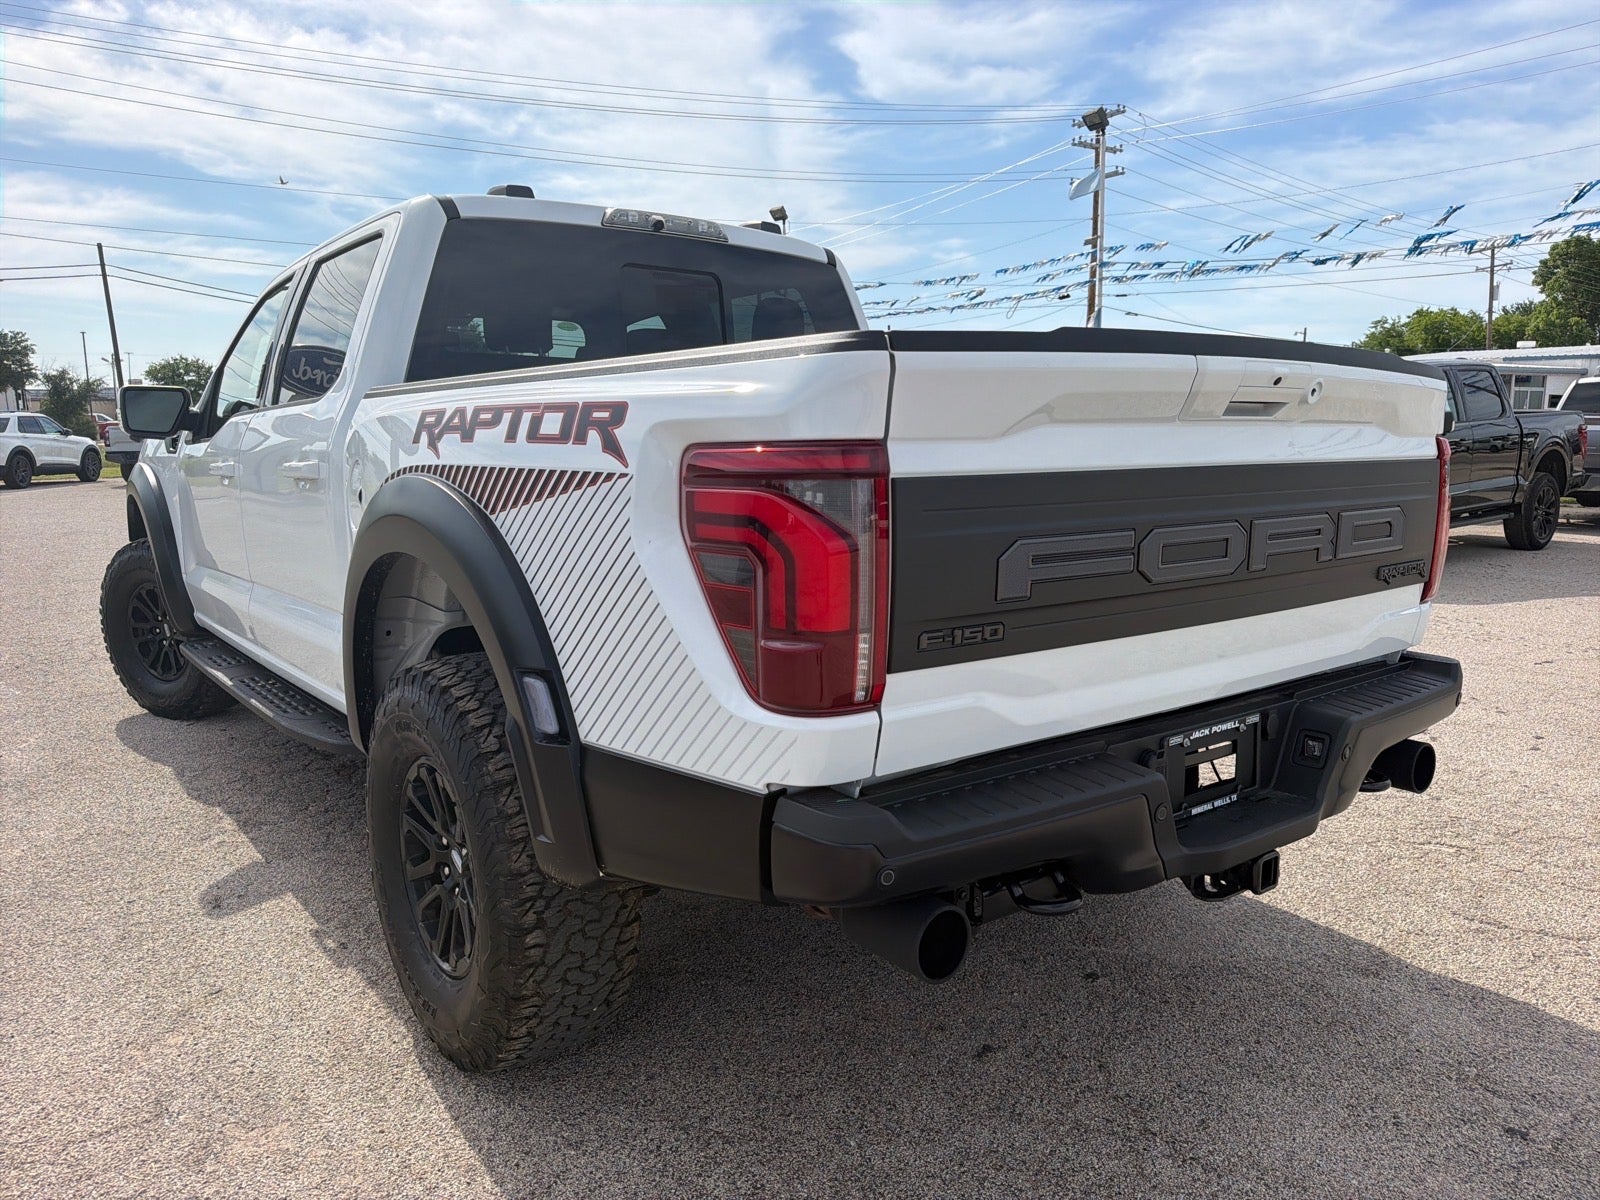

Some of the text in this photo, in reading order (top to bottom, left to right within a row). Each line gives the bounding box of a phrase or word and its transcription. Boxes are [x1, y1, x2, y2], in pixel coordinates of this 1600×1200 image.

[412, 401, 629, 469] RAPTOR
[996, 505, 1406, 602] FORD
[1379, 559, 1427, 584] RAPTOR
[917, 621, 1005, 652] F-150
[1190, 721, 1240, 740] JACK POWELL
[1231, 794, 1238, 802] TX
